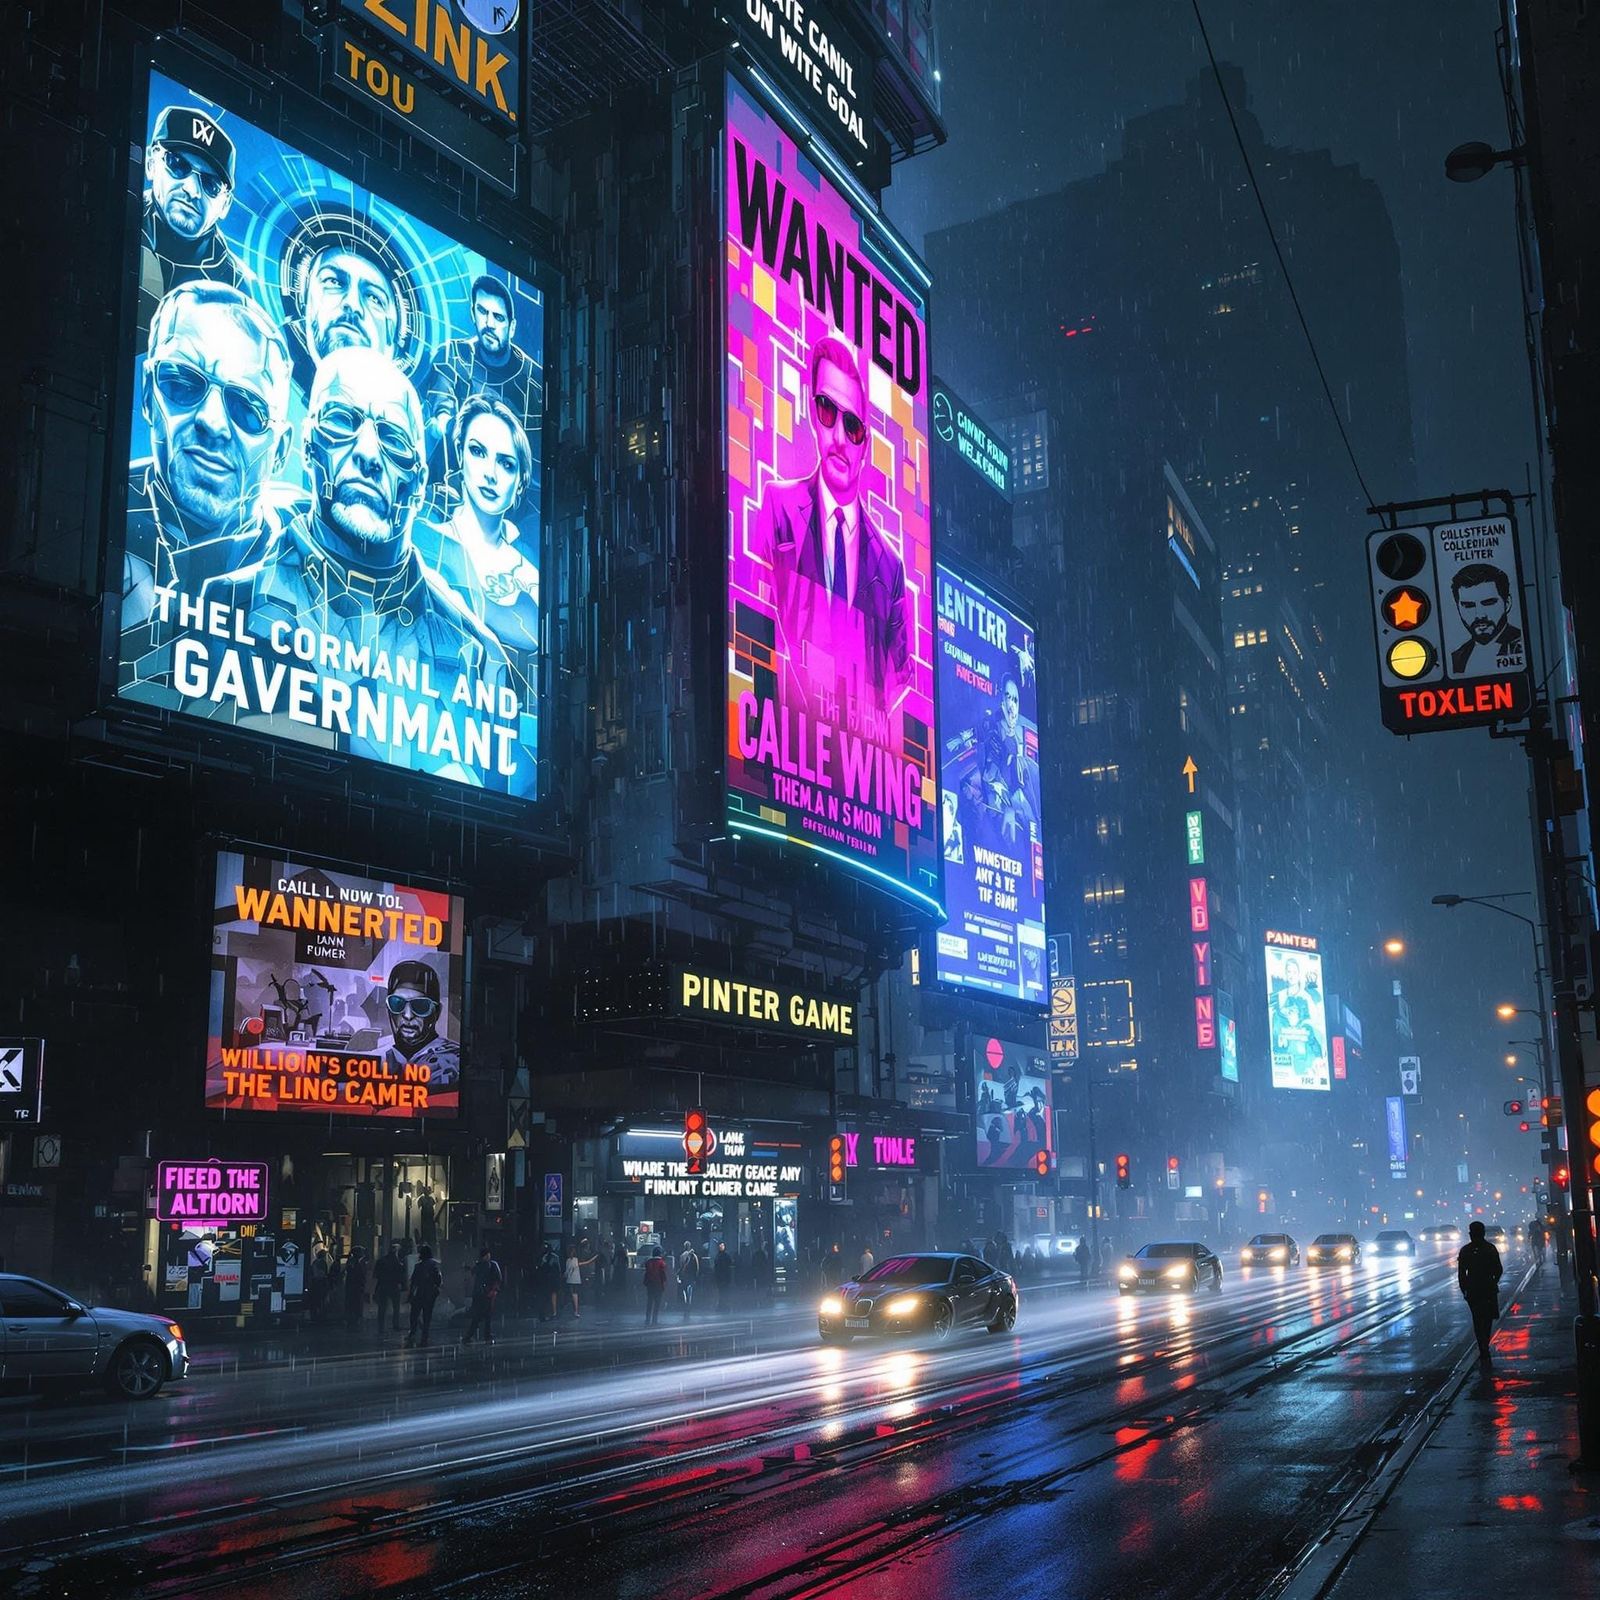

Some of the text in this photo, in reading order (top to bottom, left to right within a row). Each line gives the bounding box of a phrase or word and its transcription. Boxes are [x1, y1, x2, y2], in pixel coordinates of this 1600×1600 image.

[344, 40, 415, 114] TOU
[734, 135, 921, 398] WANTED
[154, 584, 256, 645] THEL
[270, 620, 518, 721] CORMANL AND
[1398, 682, 1513, 719] TOXLEN
[739, 690, 832, 789] CALLE
[839, 730, 922, 830] WING
[234, 884, 443, 947] WANNERTED
[376, 892, 404, 910] TOL
[682, 972, 853, 1035] PINTER GAME
[222, 1071, 429, 1109] THE LING CAMER
[405, 1062, 431, 1083] NO
[170, 1192, 259, 1216] ALTIORN
[226, 1168, 261, 1190] THE
